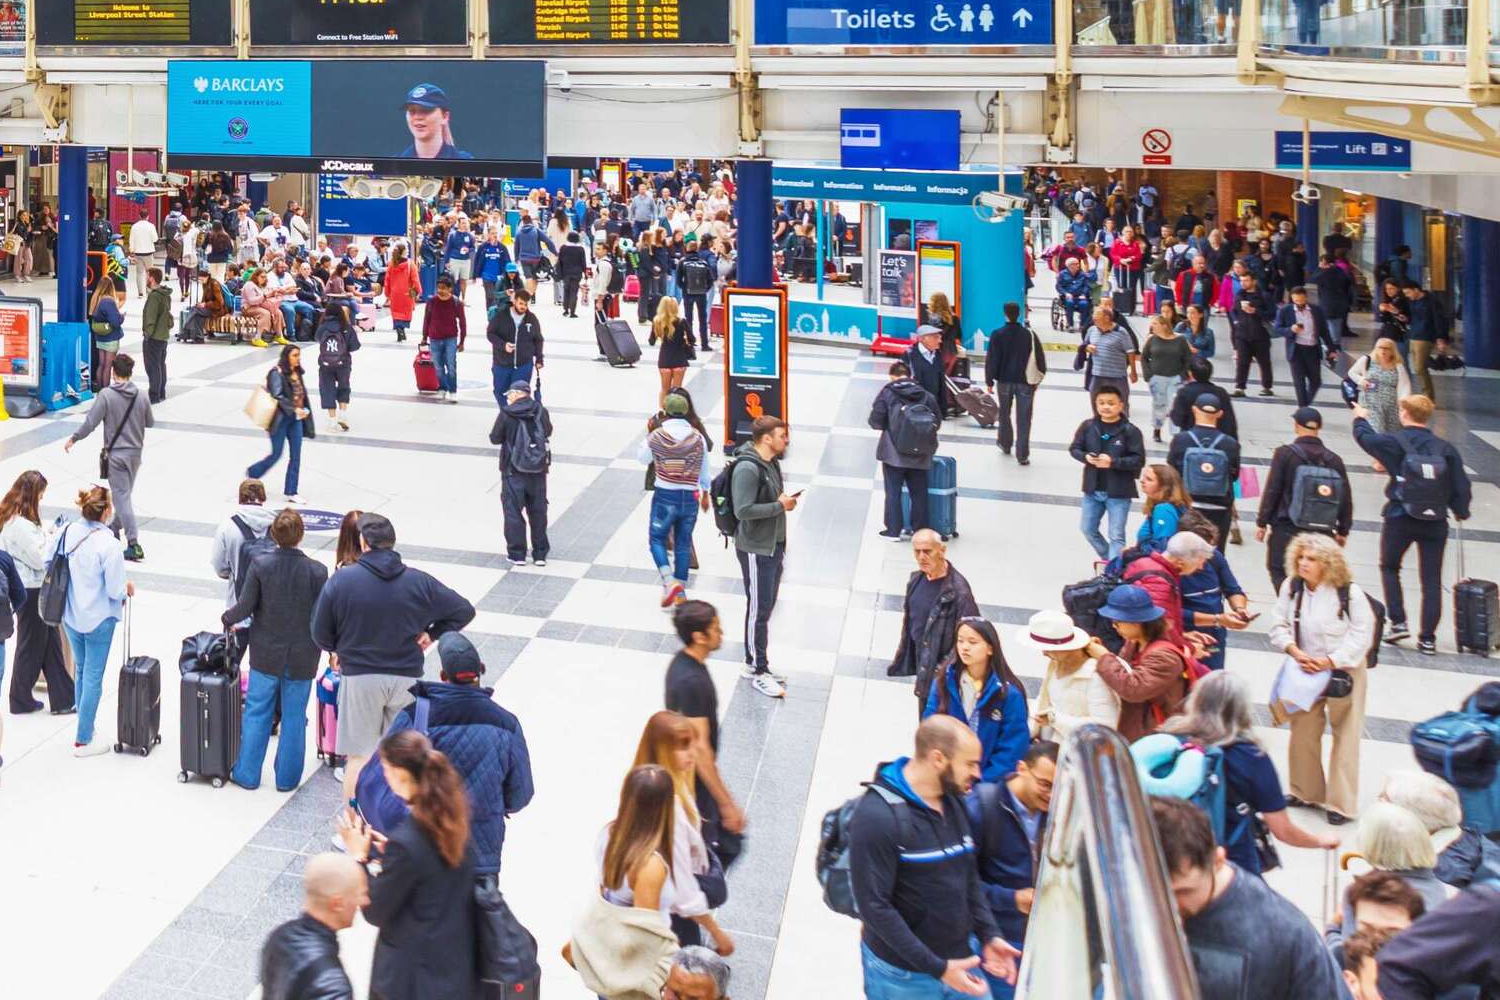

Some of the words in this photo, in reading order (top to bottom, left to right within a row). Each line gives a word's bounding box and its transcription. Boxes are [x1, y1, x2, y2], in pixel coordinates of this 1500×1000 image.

[112, 3, 139, 12] Welcome
[141, 3, 150, 11] to
[89, 12, 122, 21] Liverpool
[123, 11, 147, 19] Street
[149, 11, 175, 19] Station
[830, 8, 915, 29] Toilets
[349, 33, 361, 41] Free
[385, 33, 398, 41] WiFi
[212, 78, 284, 92] BARCLAYS
[1345, 144, 1366, 154] Lift
[321, 160, 374, 171] JCDecaux
[823, 181, 864, 190] Information
[873, 183, 917, 192] Información
[927, 185, 969, 195] Informacja
[881, 255, 907, 267] Let's
[881, 267, 902, 278] talk
